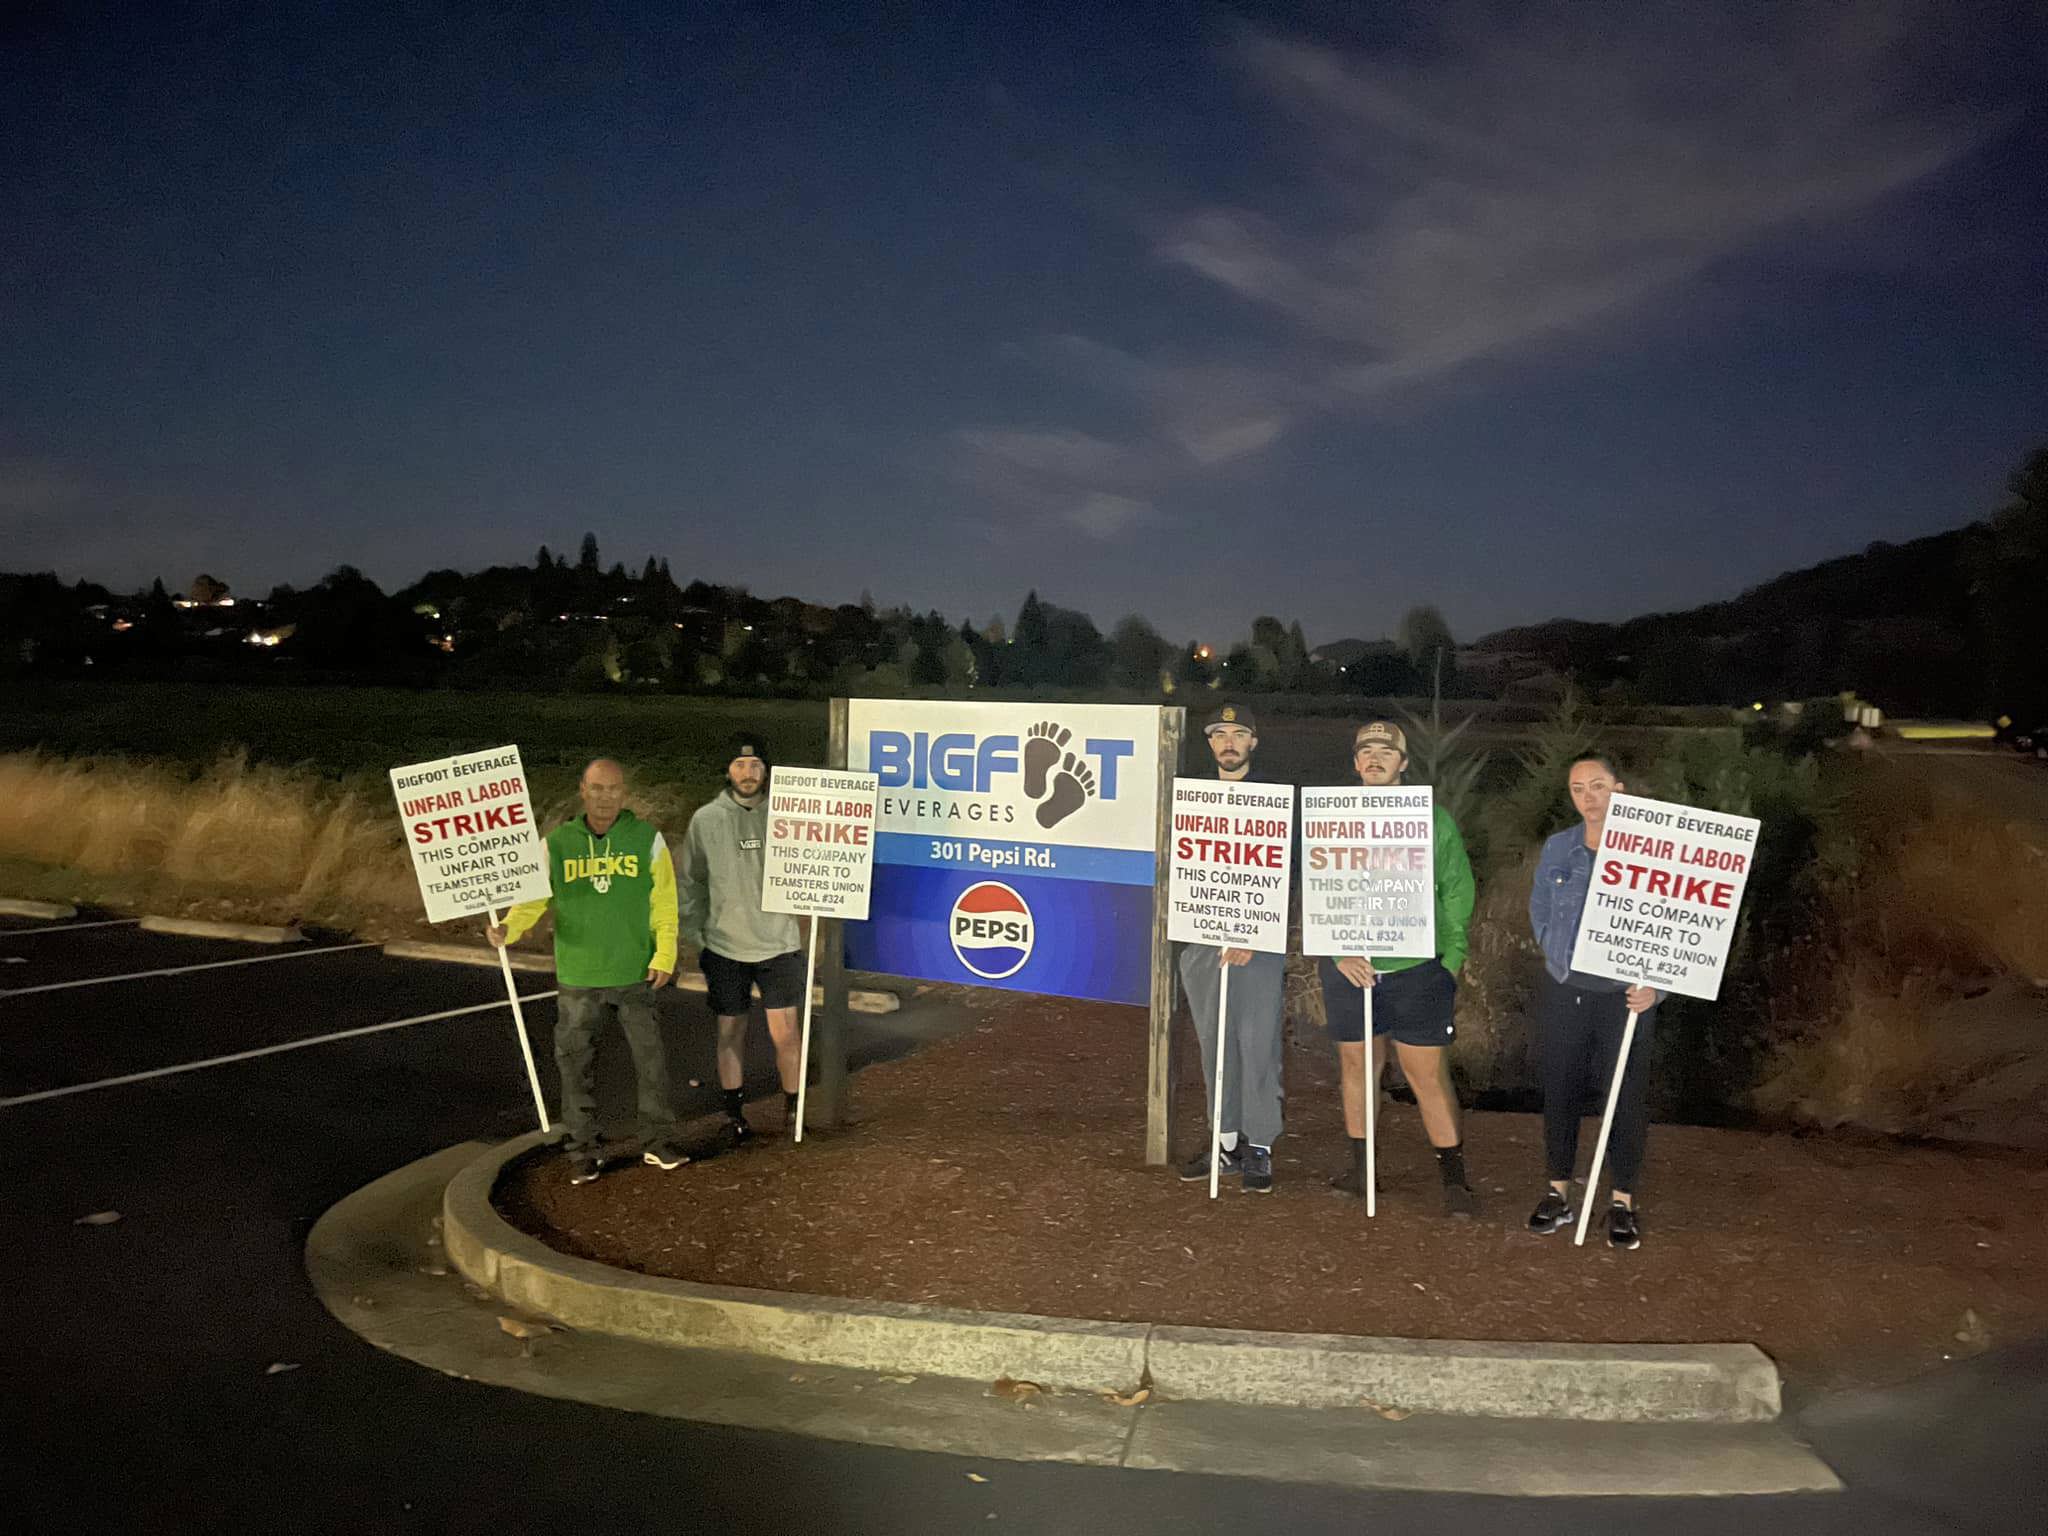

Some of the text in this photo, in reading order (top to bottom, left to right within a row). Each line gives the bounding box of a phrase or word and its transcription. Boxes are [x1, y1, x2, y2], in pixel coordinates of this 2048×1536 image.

[397, 754, 518, 789] BIGFOOT BEVERAGE
[869, 730, 1134, 800] BIGFT
[774, 775, 876, 791] BIGFOOT BEVERAGE
[402, 777, 523, 817] UNFAIR LABOR
[772, 796, 872, 818] UNFAIR LABOR
[1176, 790, 1290, 809] BIGFOOT BEVERAGE
[1305, 796, 1429, 808] BIGFOOT BEVERAGE
[884, 798, 1014, 823] EVERAGES
[1612, 804, 1754, 842] BIGFOOT BEVERAGE
[414, 803, 528, 844] STRIKE
[773, 818, 868, 846] STRIKE
[1175, 814, 1287, 839] UNFAIR LABOR
[1305, 821, 1428, 839] UNFAIR LABOR
[420, 831, 530, 864] THIS COMPANY
[772, 846, 866, 864] THIS COMPANY
[930, 841, 1056, 869] 301 Pepsi Rd.
[1177, 837, 1283, 868] STRIKE
[1310, 847, 1426, 870] STRIKE
[1605, 830, 1746, 874] UNFAIR LABOR
[440, 851, 519, 877] UNFAIR TO
[564, 855, 638, 883] DUCKS
[784, 862, 850, 878] UNFAIR TO
[427, 862, 539, 894] TEAMSTERS UNION
[769, 877, 864, 893] TEAMSTERS UNION
[1176, 867, 1282, 889] THIS COMPANY
[1309, 878, 1424, 892] THIS COMPANY
[1601, 861, 1735, 909] STRIKE
[452, 888, 493, 903] LOCAL
[496, 881, 521, 894] #324
[786, 891, 844, 904] LOCAL #324
[1190, 886, 1264, 905] UNFAIR TO
[1387, 897, 1408, 910] TO
[1174, 901, 1281, 923] TEAMSTERS UNION
[1388, 917, 1427, 927] UNION
[1596, 892, 1727, 931] THIS COMPANY
[955, 917, 1028, 942] PEPSI
[1194, 919, 1259, 935] LOCAL #324
[1332, 930, 1404, 941] LOCAL #324
[1610, 915, 1701, 946] UNFAIR TO
[1587, 930, 1717, 967] TEAMSTERS UNION
[1607, 951, 1687, 977] LOCAL #324
